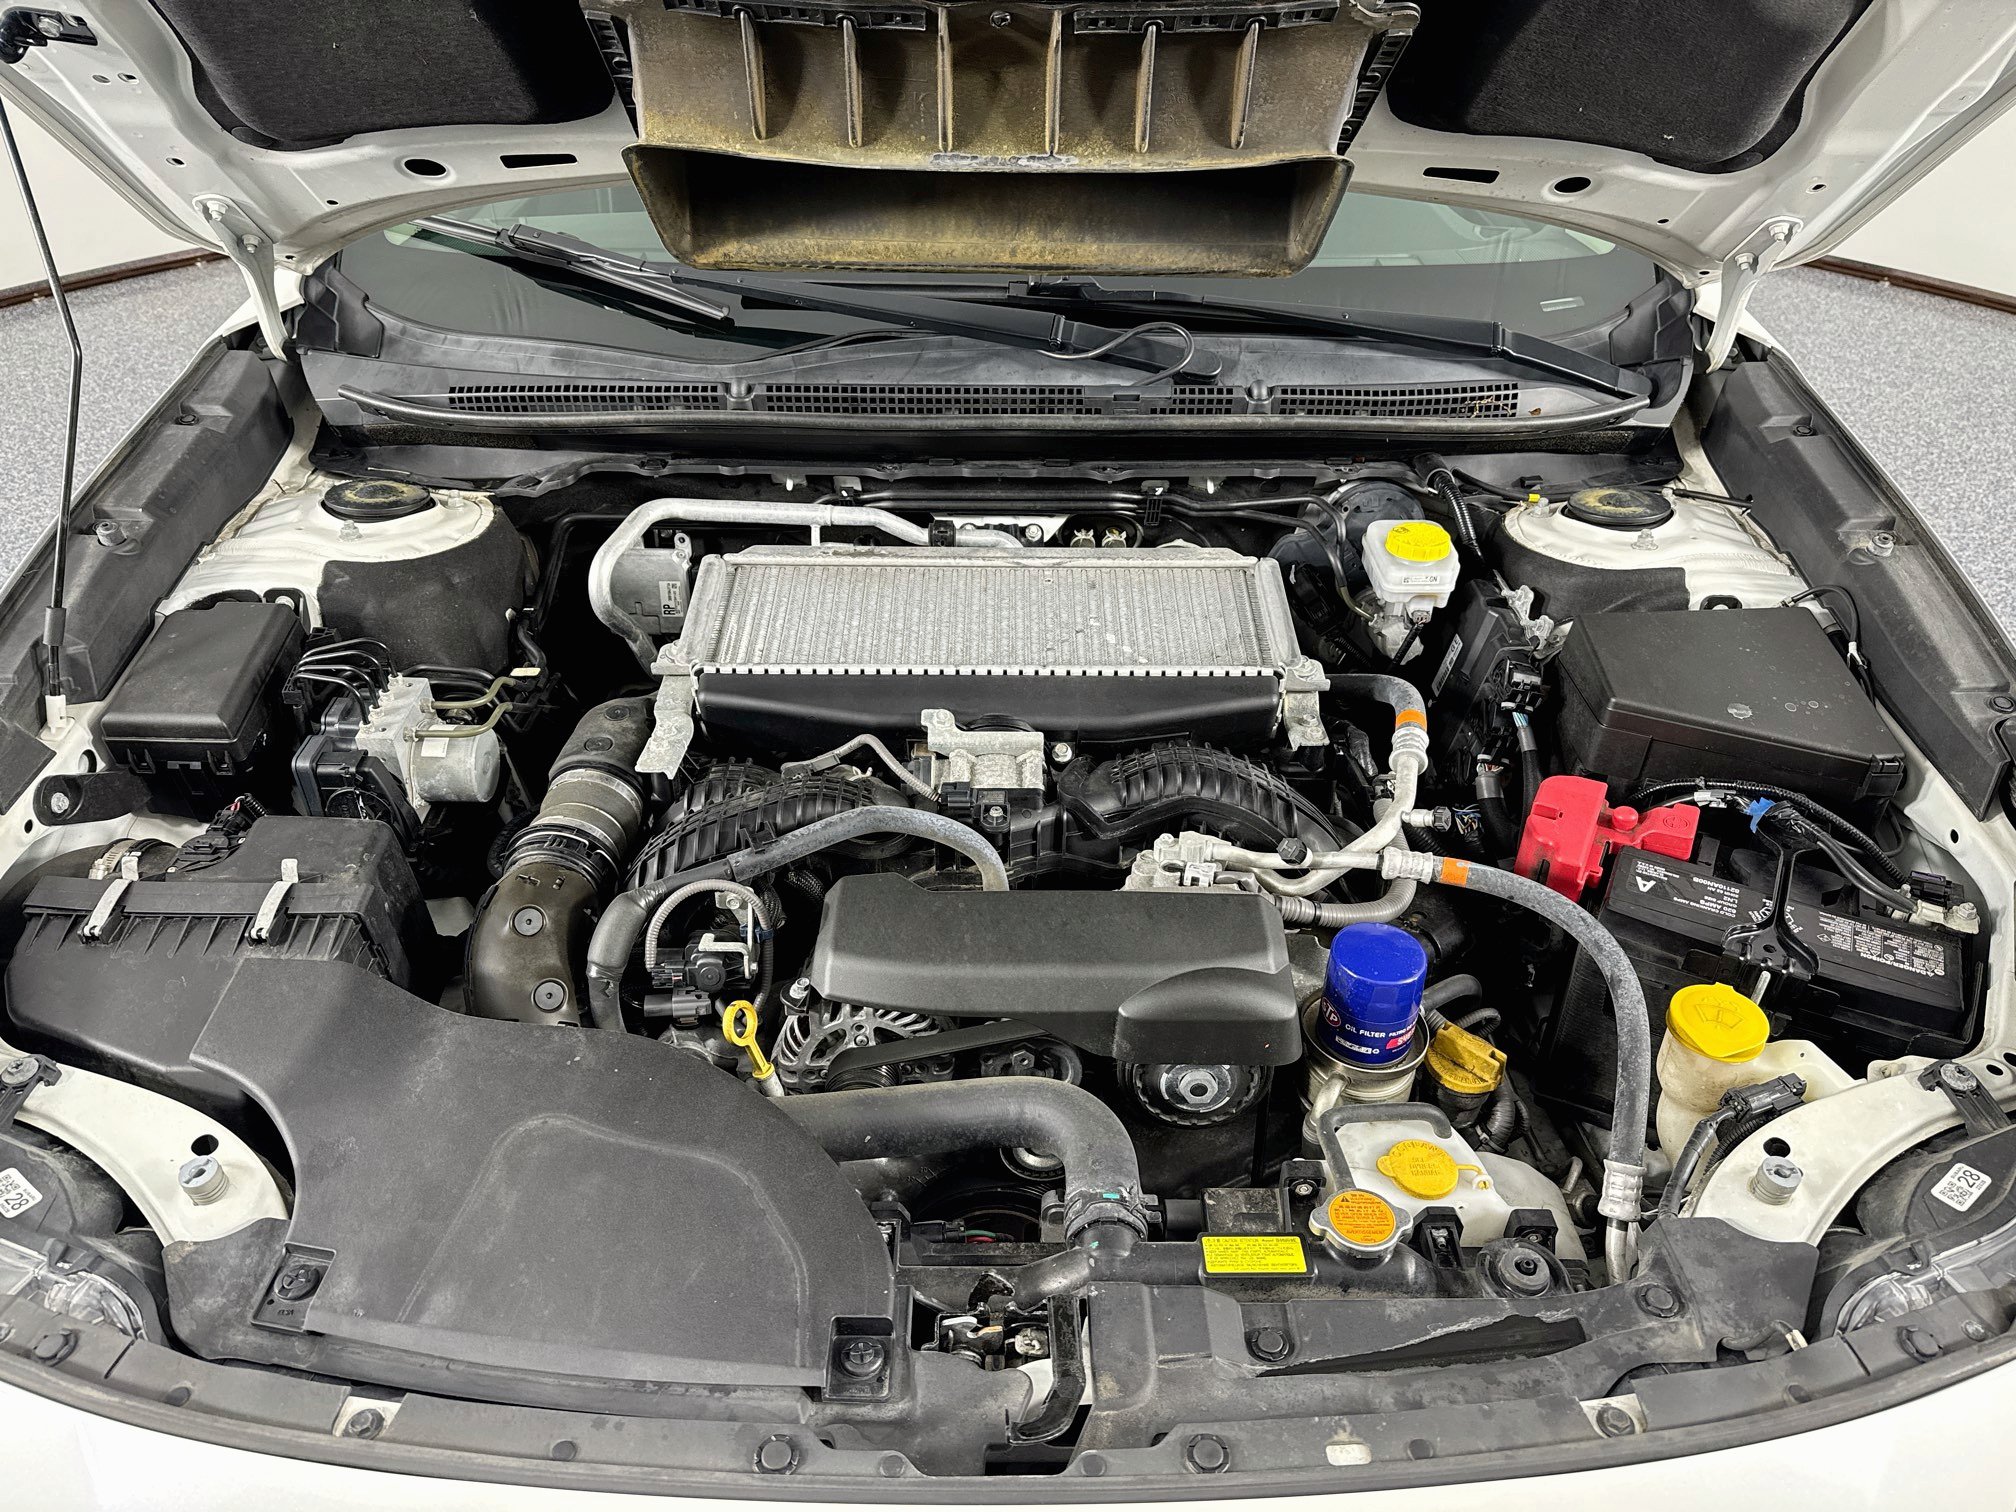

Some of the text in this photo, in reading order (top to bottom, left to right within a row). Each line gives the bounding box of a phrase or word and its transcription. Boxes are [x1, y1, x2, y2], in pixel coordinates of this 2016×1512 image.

[663, 604, 676, 615] RP
[1635, 875, 1657, 893] A
[1699, 899, 1723, 911] AMPS
[1719, 899, 1738, 908] GROUP
[1719, 910, 1736, 918] COLD
[1860, 952, 1927, 975] DANGER/POISON
[1345, 1023, 1357, 1033] OIL
[1359, 1029, 1386, 1038] FILTER
[1957, 1170, 1981, 1188] 28
[4, 1192, 30, 1211] 28
